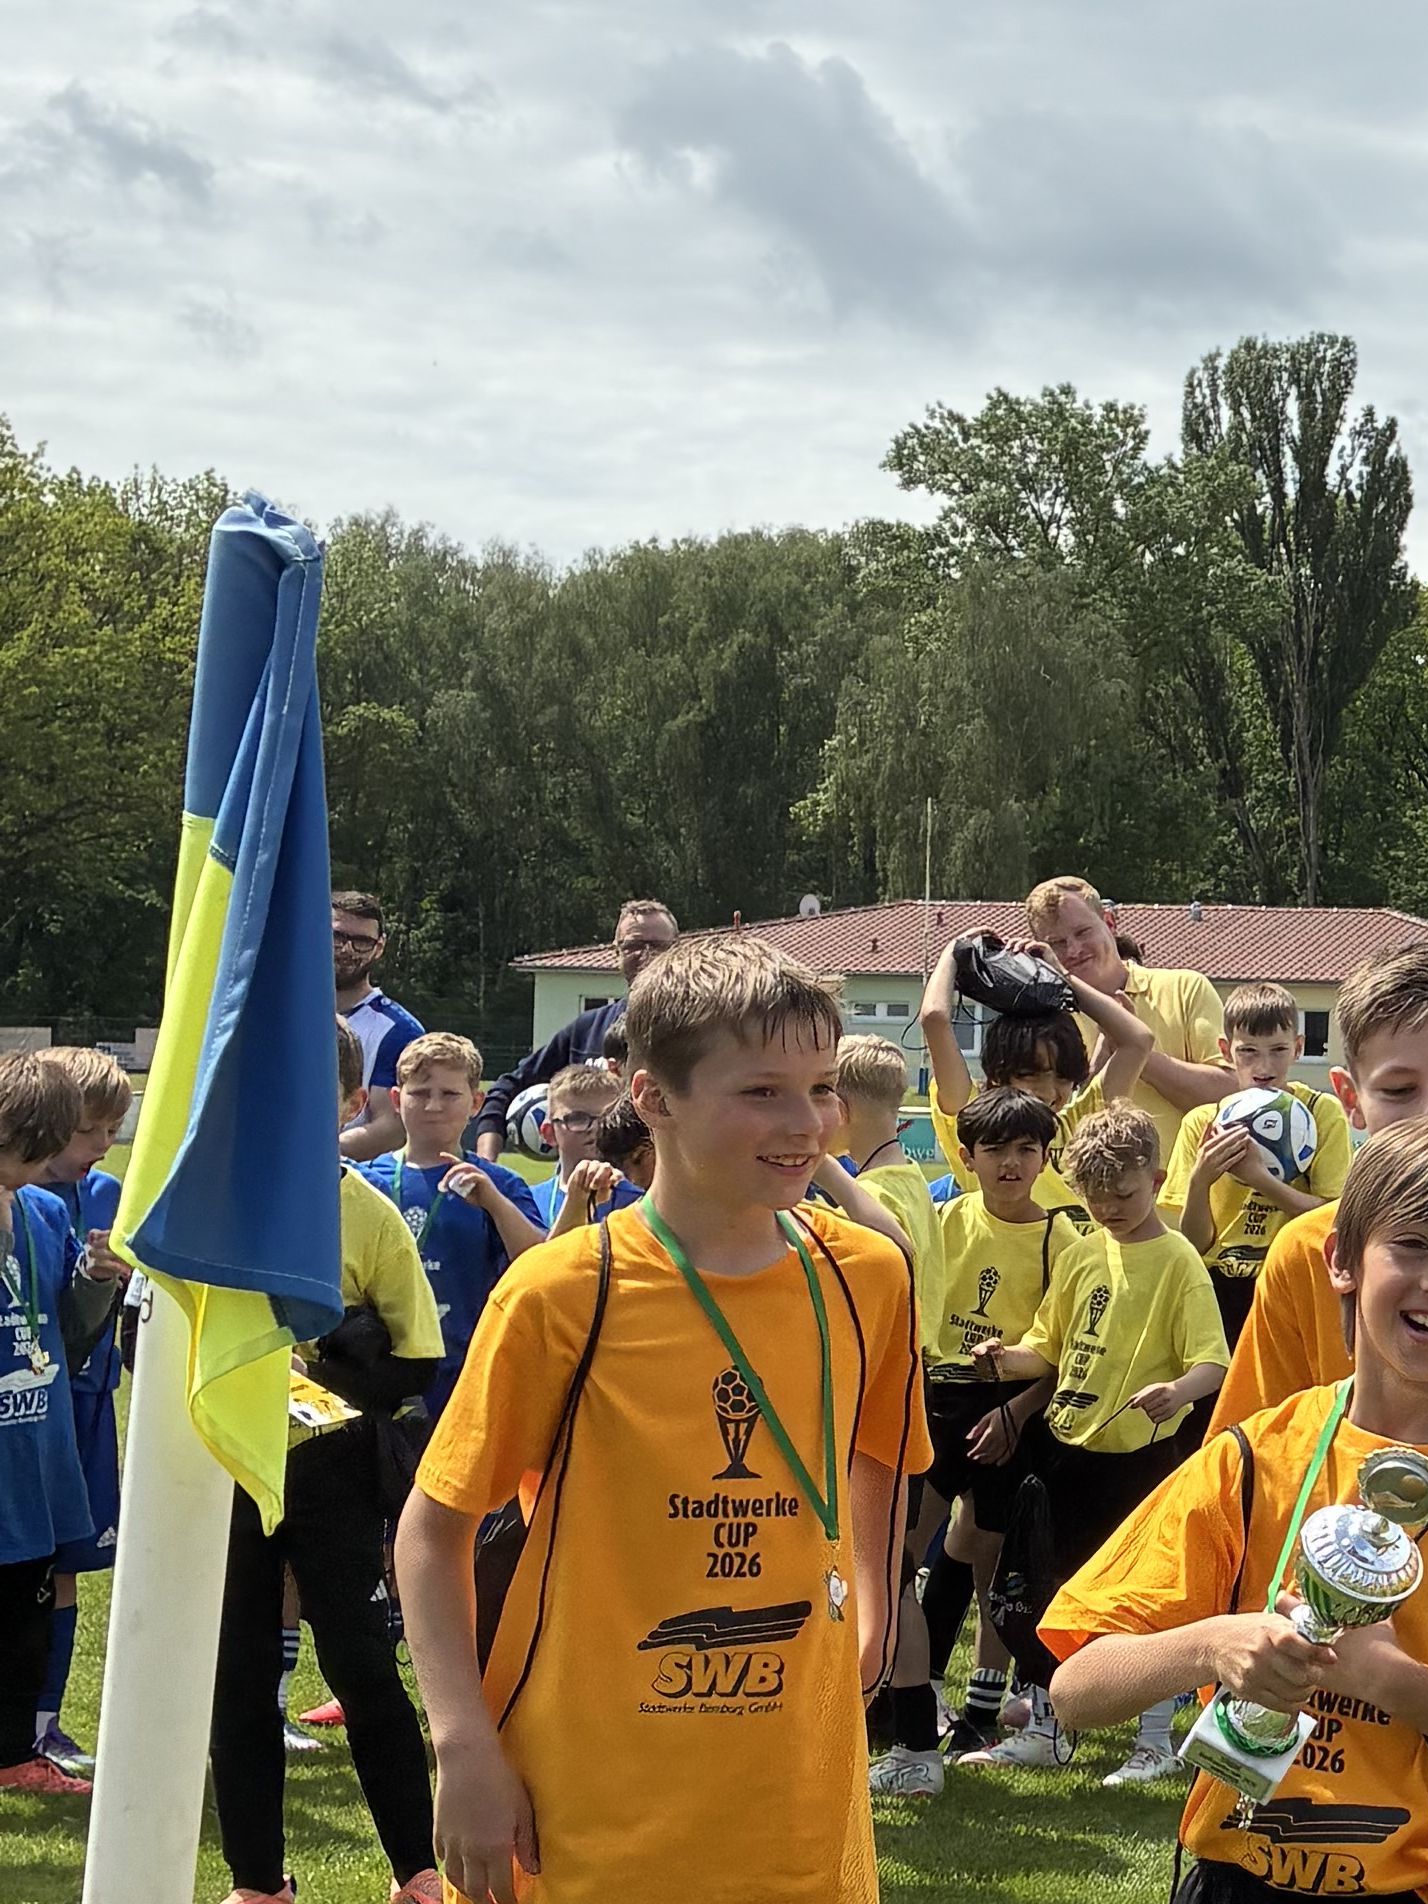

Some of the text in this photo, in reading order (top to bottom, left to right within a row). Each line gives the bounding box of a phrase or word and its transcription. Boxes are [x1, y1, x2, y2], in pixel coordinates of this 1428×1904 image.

[668, 1491, 799, 1520] Stadtwerke
[713, 1522, 758, 1548] CUP
[705, 1551, 763, 1579] 2026
[651, 1651, 786, 1699] SWB
[1308, 1715, 1343, 1743] UP
[1294, 1742, 1345, 1774] 026
[1241, 1837, 1366, 1894] SWB
